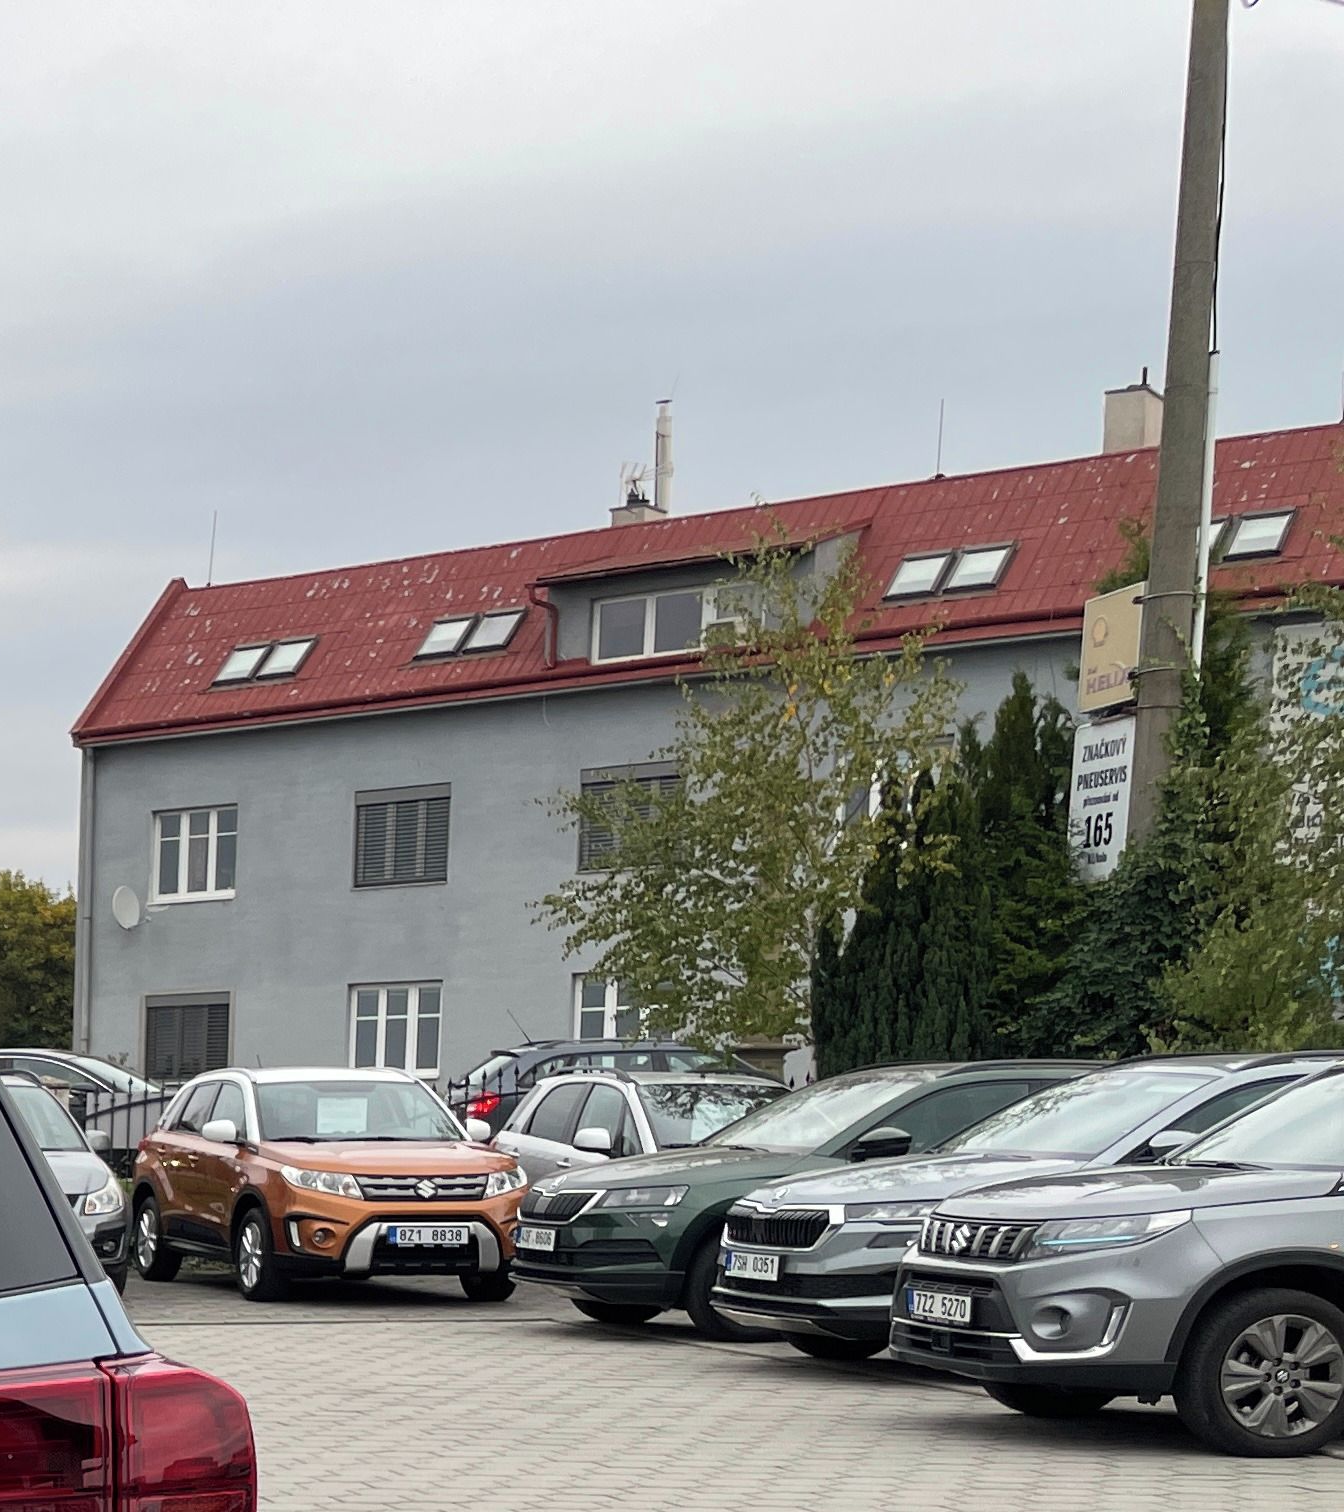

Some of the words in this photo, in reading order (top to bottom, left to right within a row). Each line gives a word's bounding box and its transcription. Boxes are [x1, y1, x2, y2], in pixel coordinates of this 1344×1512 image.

[1082, 734, 1127, 763] ZNAČKOVÝ
[1076, 765, 1128, 791] PNEUSERVIS
[1083, 812, 1113, 849] 165
[399, 1229, 422, 1242] 8Z1
[431, 1229, 462, 1242] 8838
[752, 1256, 775, 1274] 0351
[916, 1292, 935, 1314] 7Z2
[941, 1296, 966, 1319] 5270
